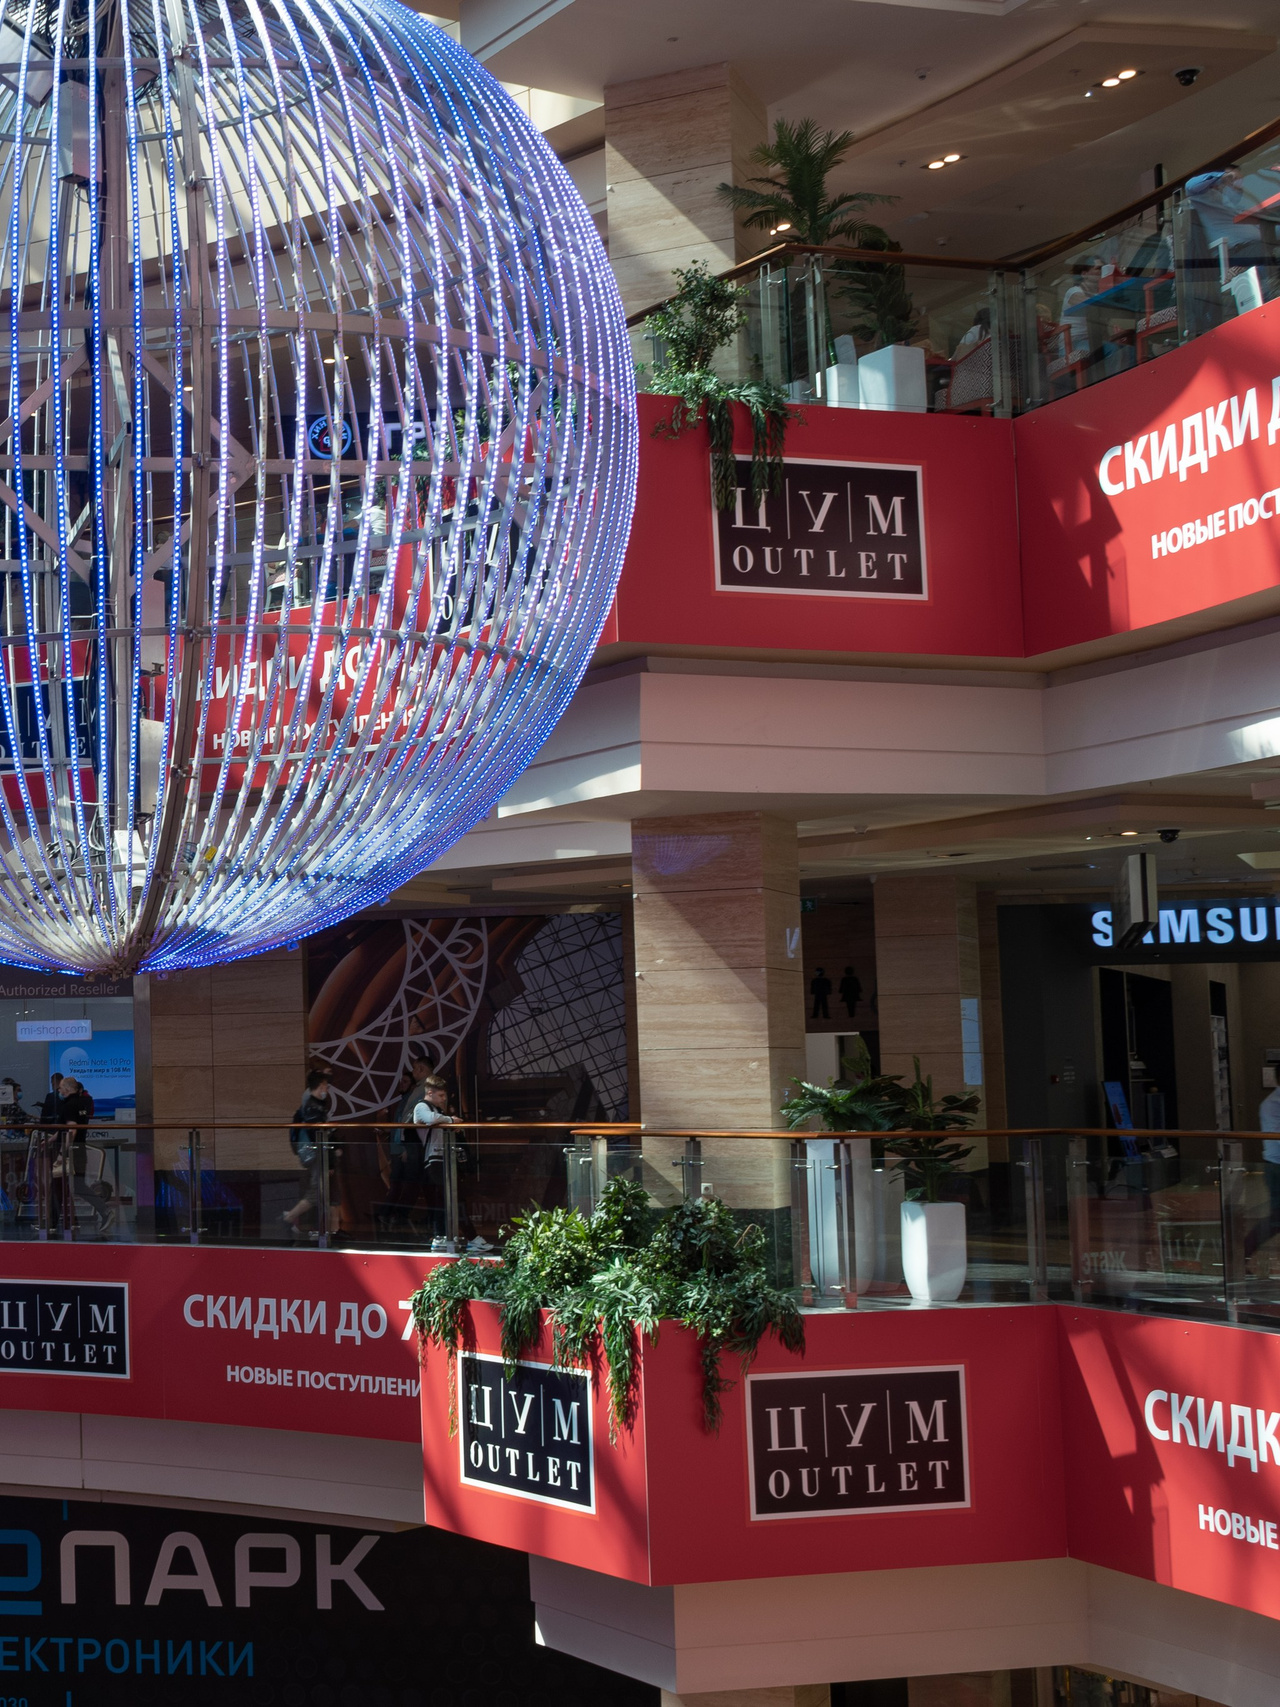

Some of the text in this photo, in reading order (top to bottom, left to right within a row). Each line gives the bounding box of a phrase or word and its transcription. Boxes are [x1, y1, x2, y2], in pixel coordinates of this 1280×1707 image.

[1098, 387, 1260, 496] СКИДКИ
[730, 487, 908, 537] ЦУМ
[1151, 509, 1227, 560] НОВЫЕ
[732, 545, 908, 581] OUTLET
[1091, 907, 1280, 947] SMSU
[70, 983, 120, 996] Reseller
[20, 1024, 88, 1036] mi-shop.com
[91, 1058, 108, 1066] Note
[0, 1300, 117, 1334] ЦУМ
[183, 1294, 327, 1340] СКИДКИ
[335, 1302, 388, 1346] ДО
[0, 1340, 117, 1365] OUTLET
[226, 1364, 293, 1387] НОВЫЕ
[469, 1383, 581, 1445] ЦУМ
[765, 1399, 950, 1453] ЦУМ
[1144, 1389, 1280, 1473] СКИДК
[469, 1440, 582, 1491] OUTLET
[768, 1460, 950, 1499] OUTLET
[1198, 1503, 1280, 1550] НОВЫЕ
